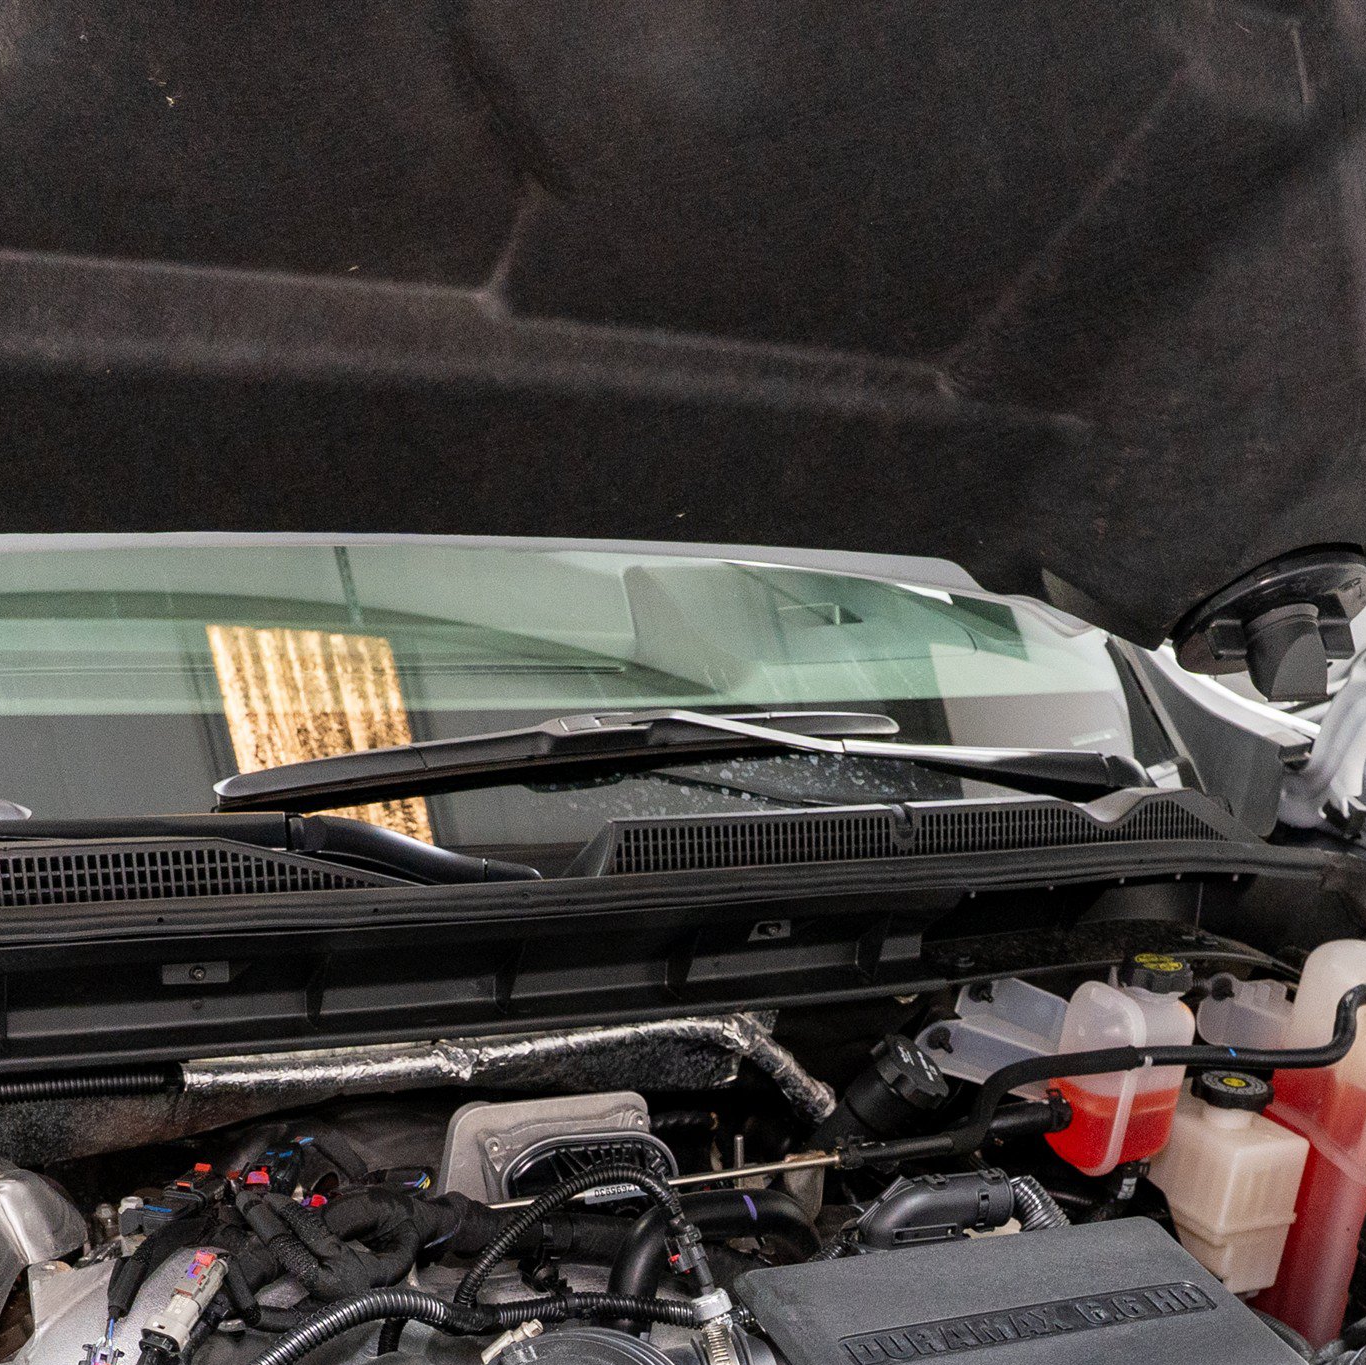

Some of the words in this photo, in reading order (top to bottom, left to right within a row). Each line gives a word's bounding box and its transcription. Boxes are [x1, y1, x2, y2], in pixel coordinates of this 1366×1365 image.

[844, 1306, 1069, 1365] DURAMAX
[1075, 1294, 1144, 1334] 6.6
[1143, 1283, 1211, 1316] HD
